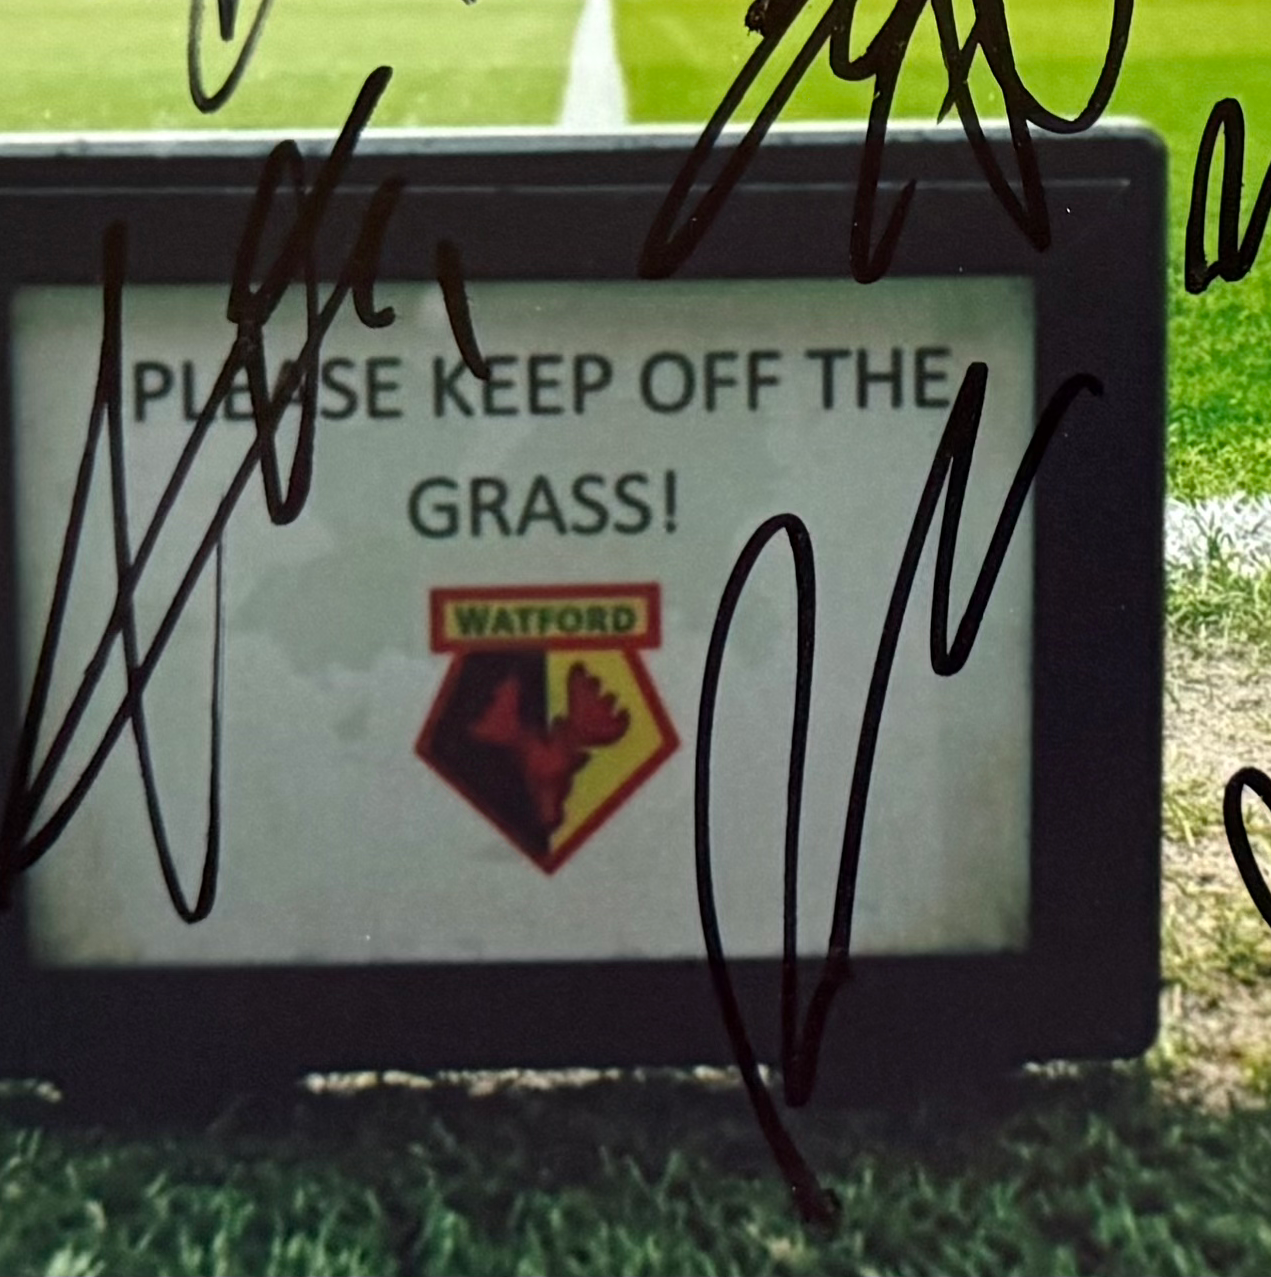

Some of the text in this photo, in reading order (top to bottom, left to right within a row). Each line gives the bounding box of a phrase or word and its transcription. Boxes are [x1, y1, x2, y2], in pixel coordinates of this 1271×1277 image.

[434, 354, 614, 416] KEEP
[639, 350, 783, 415] OFF
[805, 346, 952, 410] THE
[407, 469, 679, 540] GRASS!
[453, 604, 638, 636] WATFORD
